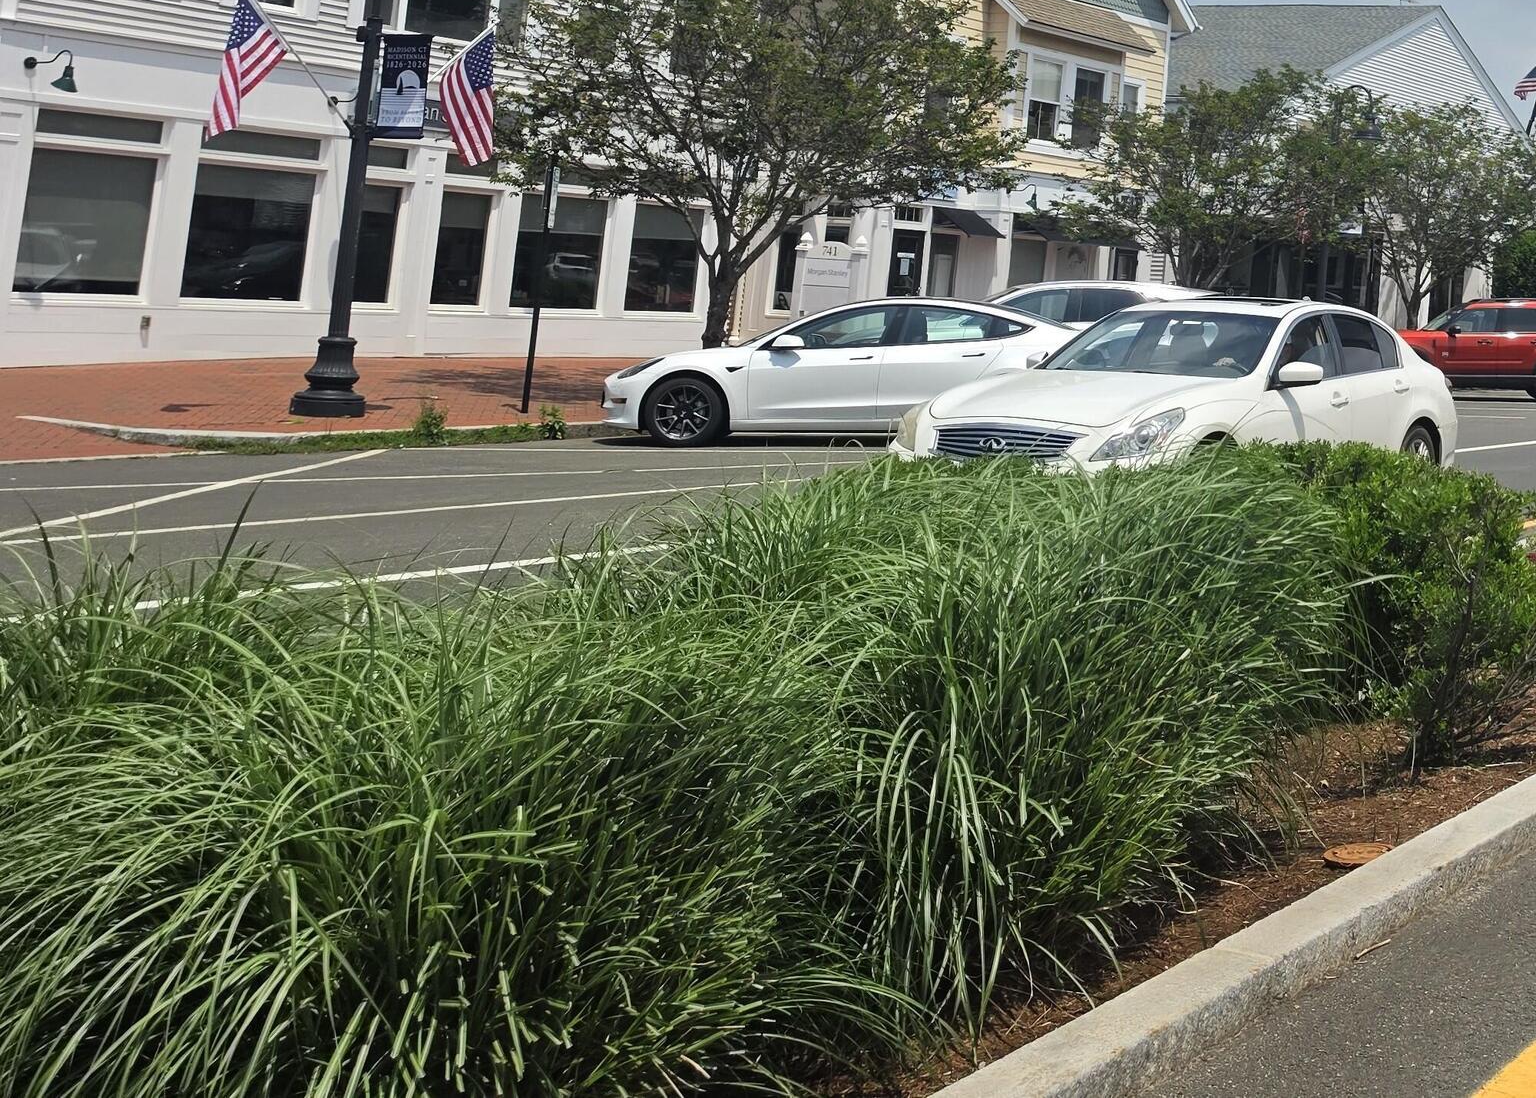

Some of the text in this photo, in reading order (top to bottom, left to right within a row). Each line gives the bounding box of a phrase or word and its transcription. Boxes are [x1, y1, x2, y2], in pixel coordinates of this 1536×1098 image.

[386, 60, 427, 68] 1826-2026
[822, 245, 838, 257] 741
[807, 267, 848, 277] Morgan Stanley
